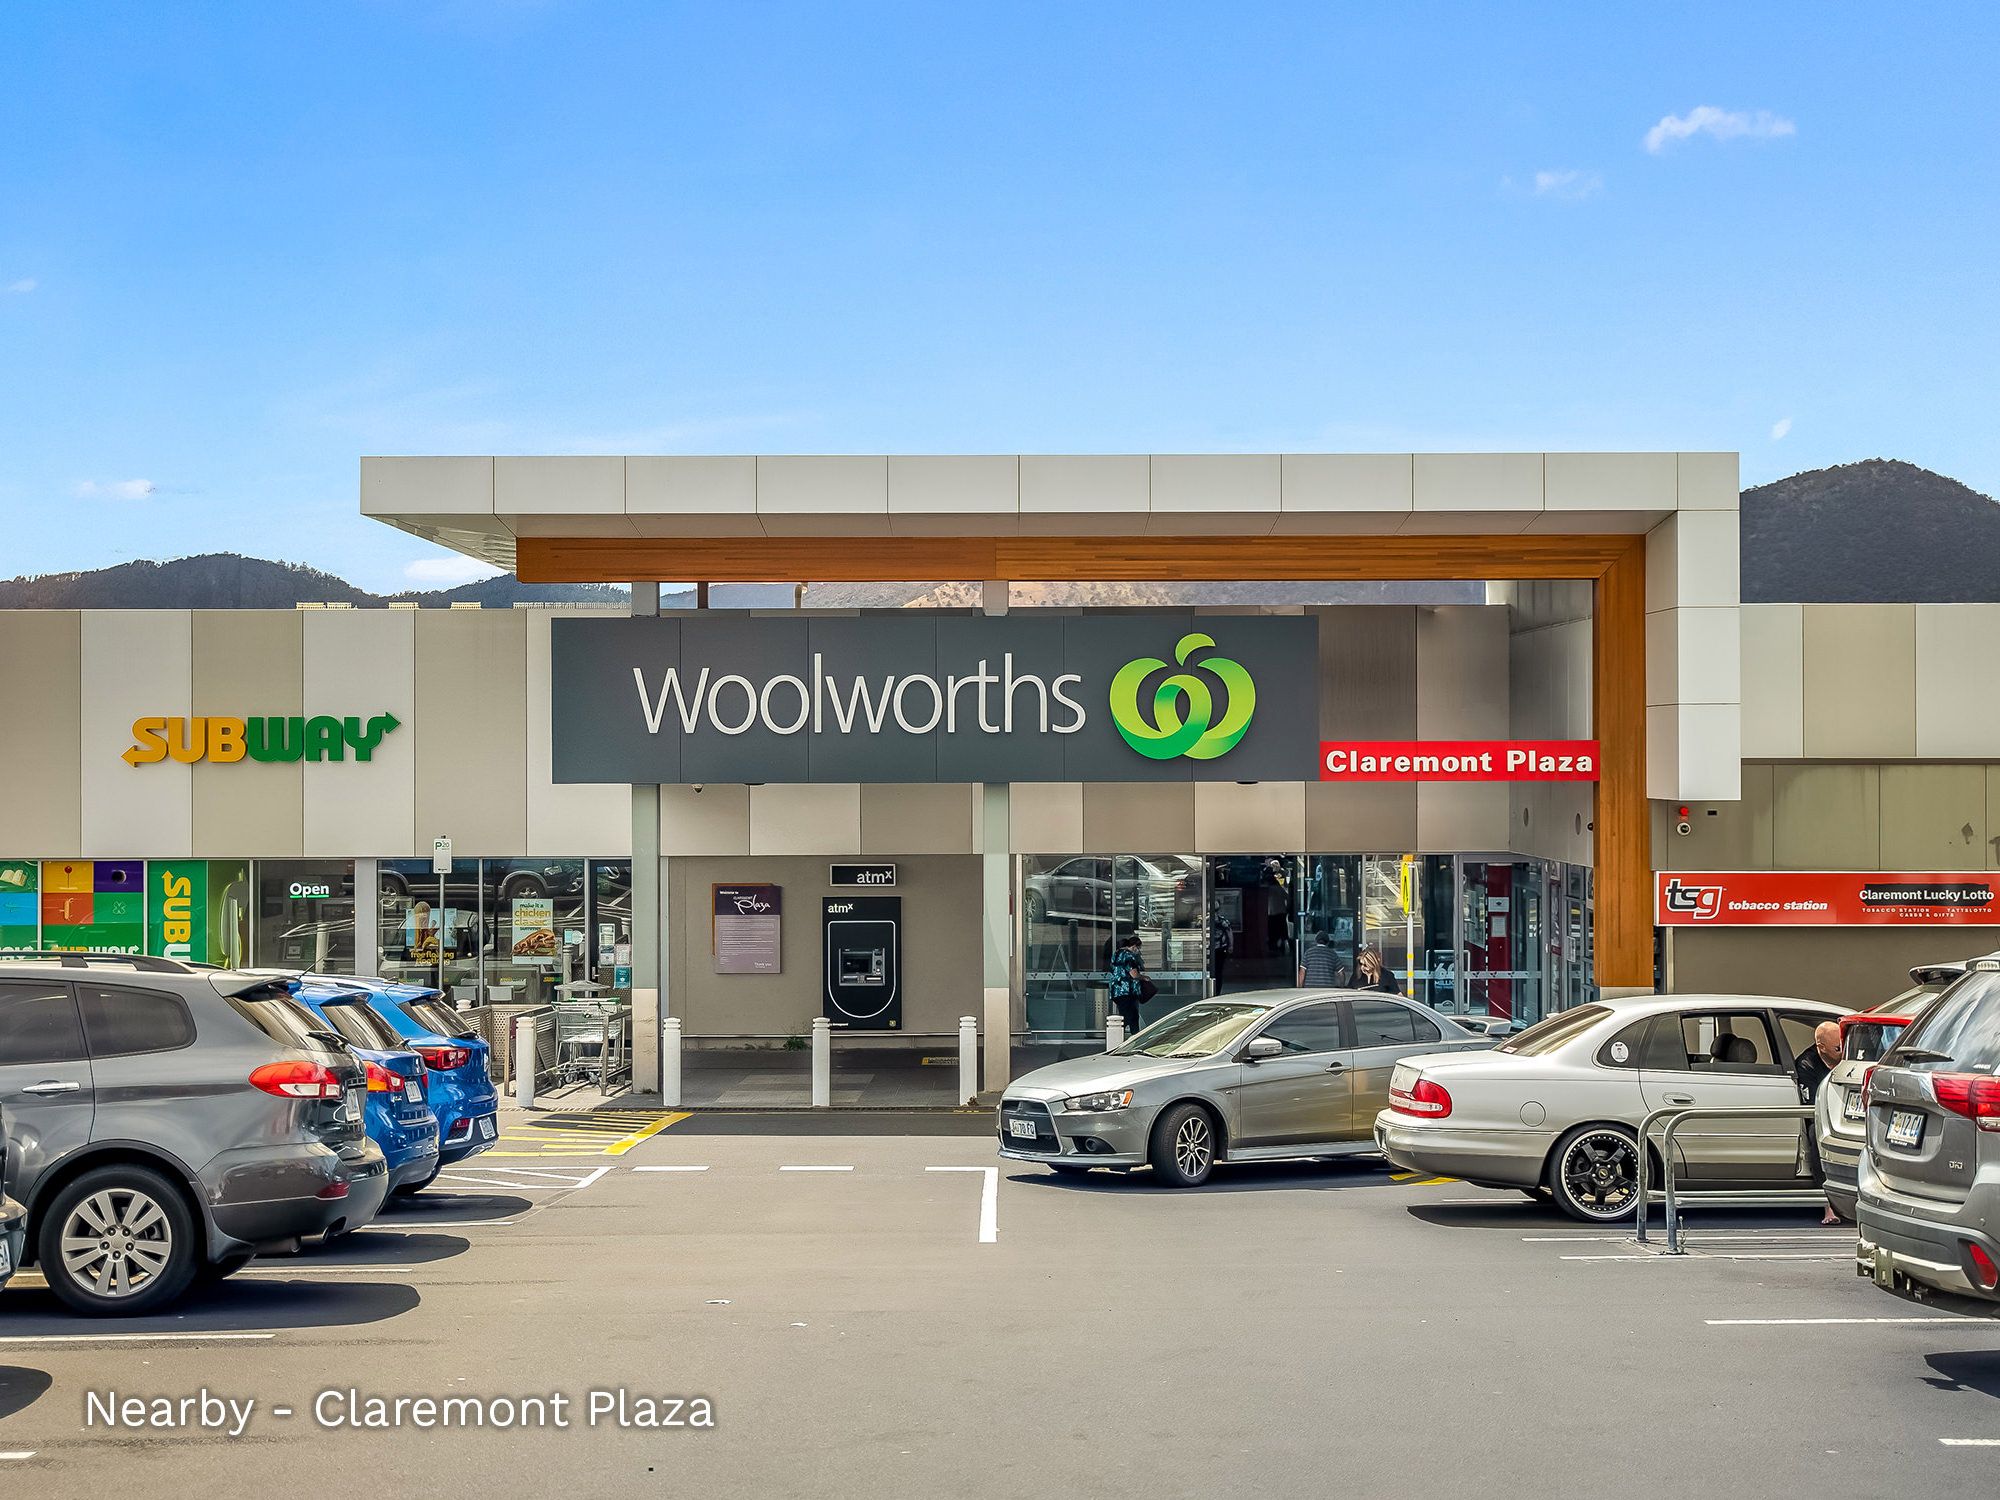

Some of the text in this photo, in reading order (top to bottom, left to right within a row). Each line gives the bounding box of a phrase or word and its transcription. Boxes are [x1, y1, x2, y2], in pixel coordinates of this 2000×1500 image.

[633, 653, 1086, 734] Woolworths
[121, 712, 401, 767] SUBWAY
[1326, 750, 1592, 772] Claremont Plaza
[290, 882, 330, 898] Open
[1665, 878, 1723, 919] tsg
[1859, 890, 1994, 902] Claremont Lucky Lotto
[515, 908, 550, 917] chicken
[1728, 900, 1828, 910] tobacco station
